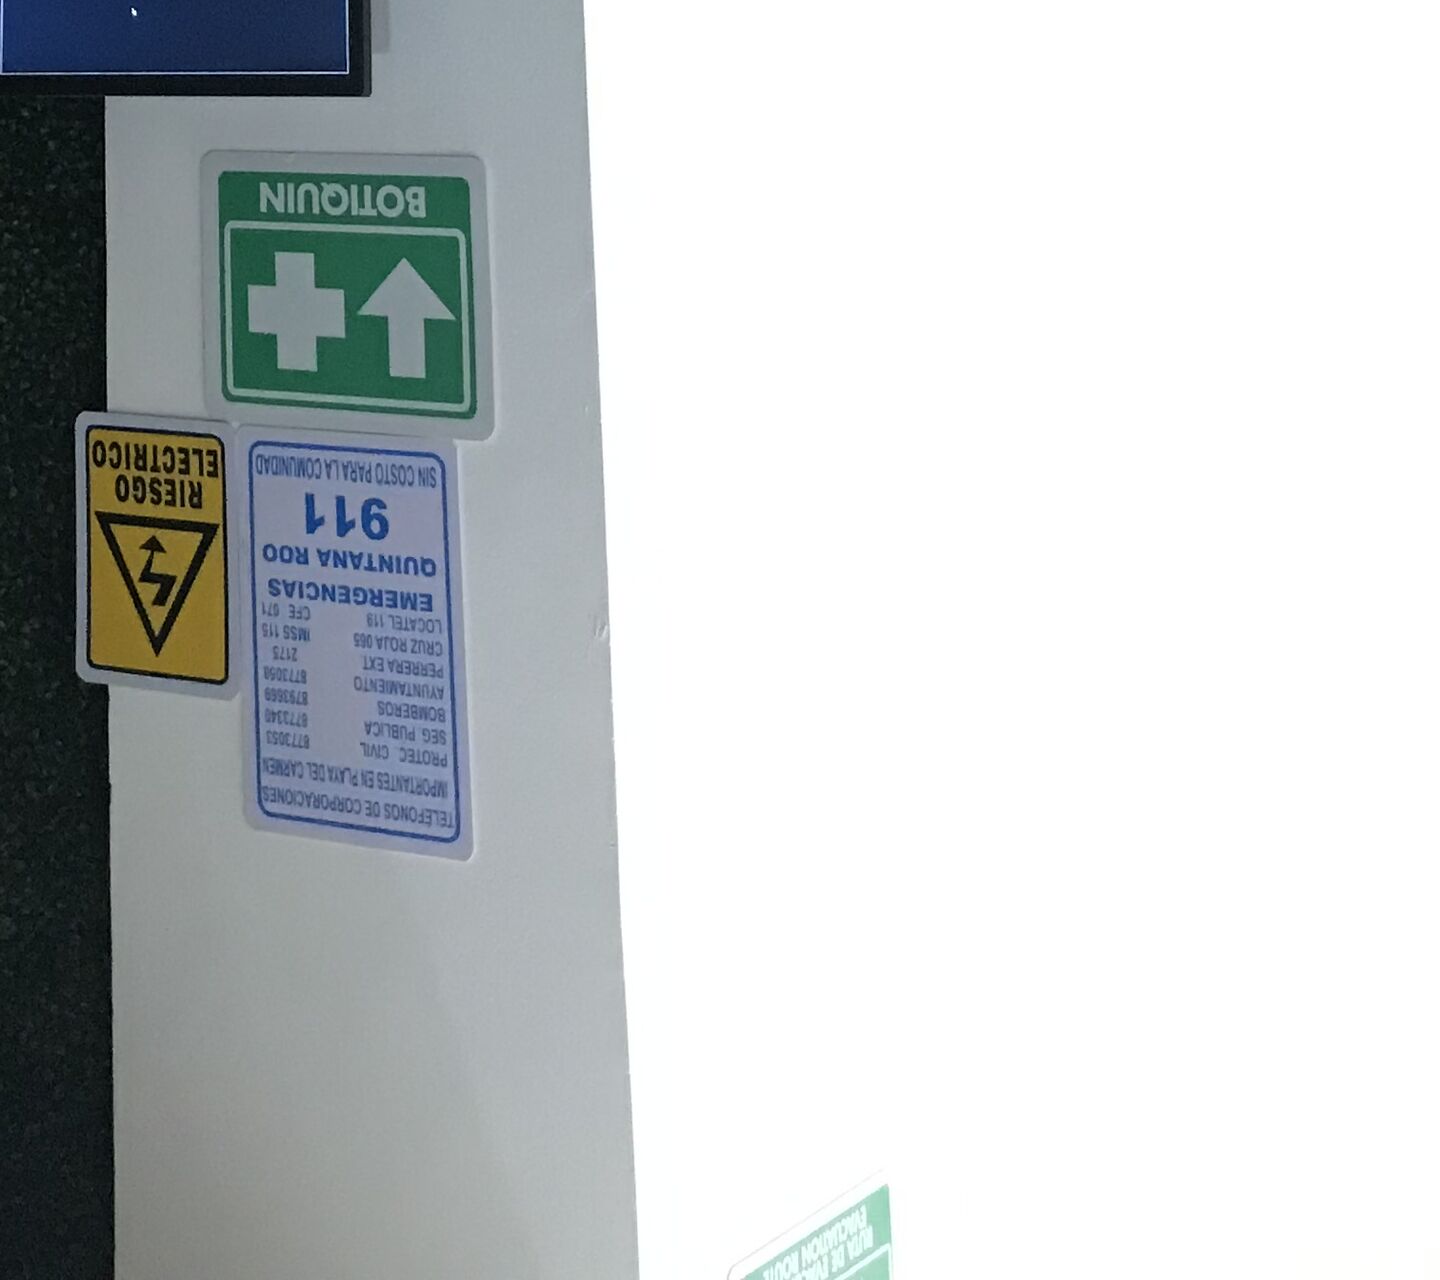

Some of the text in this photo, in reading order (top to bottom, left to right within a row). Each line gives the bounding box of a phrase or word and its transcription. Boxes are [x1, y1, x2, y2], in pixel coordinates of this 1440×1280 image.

[258, 182, 426, 218] BOTIQUIN
[91, 440, 219, 478] ELECTRICO
[255, 454, 437, 488] SIN COSTO PARA LA COMUNIDAD
[114, 474, 203, 510] RIESGO
[304, 492, 389, 541] 911
[262, 544, 437, 577] QUINTANA ROO
[267, 578, 433, 613] EMERGENCIAS
[261, 600, 311, 620] CFE 071
[261, 622, 311, 642] IMSS 115
[388, 614, 442, 634] LOCATEL
[272, 645, 298, 662] 2175
[353, 632, 443, 656] CRUZ ROJA 065
[387, 659, 444, 678] PERRERA
[353, 676, 445, 700] AYUNTAMIENTO
[377, 700, 446, 723] BOMBEROS
[360, 742, 389, 760] CIVIL
[262, 757, 448, 799] IMPORTANTES EN PLAYA DEL CARMEN
[260, 786, 361, 815] CORPORACIONES
[365, 800, 380, 817] DE
[800, 1204, 867, 1267] EVACUATION
[830, 1245, 844, 1272] DE
